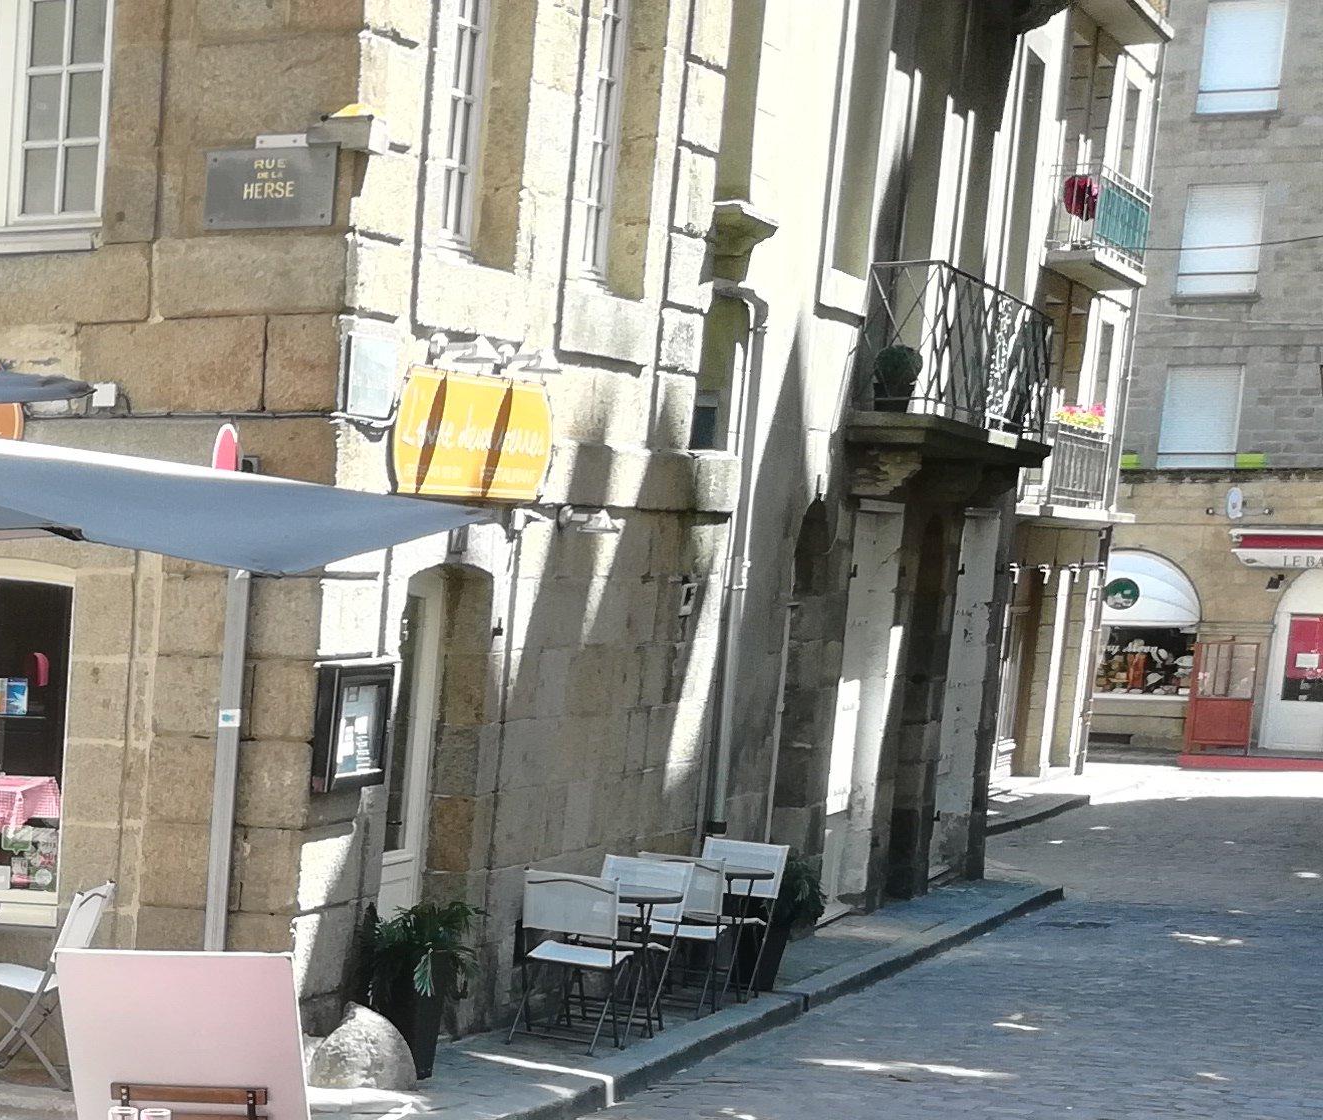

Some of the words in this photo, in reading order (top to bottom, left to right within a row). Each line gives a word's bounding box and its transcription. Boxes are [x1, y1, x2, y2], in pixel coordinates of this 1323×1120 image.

[253, 158, 287, 170] RUE
[256, 171, 270, 179] DE
[271, 171, 284, 179] LA
[242, 180, 296, 201] HERSE
